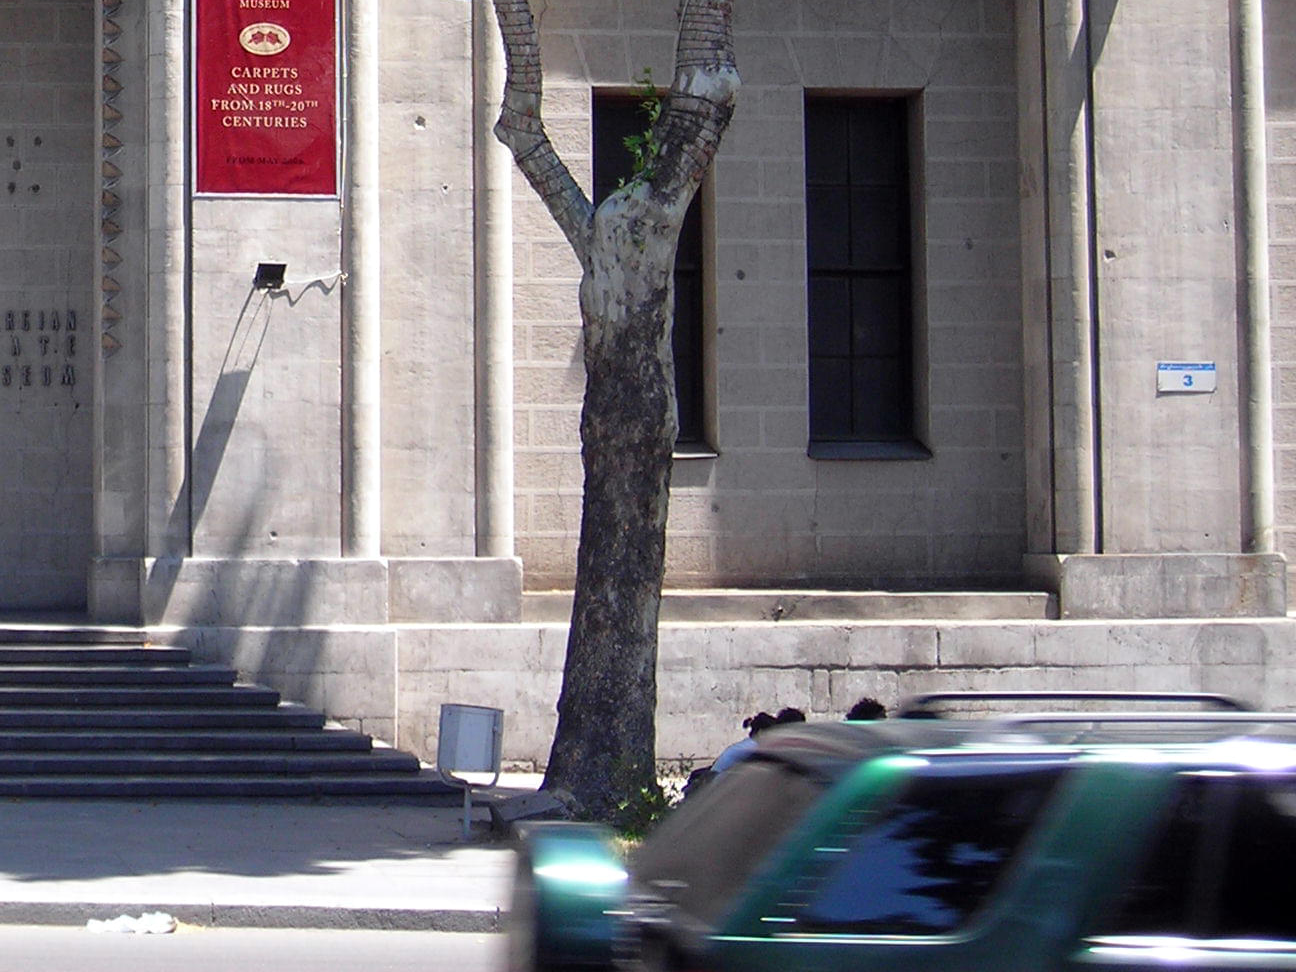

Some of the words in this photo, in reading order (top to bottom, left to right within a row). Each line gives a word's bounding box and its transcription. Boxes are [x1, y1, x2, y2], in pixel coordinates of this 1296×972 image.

[240, 0, 290, 8] MUSEUM
[231, 67, 298, 78] CARPETS
[227, 84, 260, 95] AND
[265, 84, 302, 95] RUGS
[211, 100, 254, 110] FROM
[222, 116, 307, 128] CENTURIES
[1183, 375, 1193, 387] 3
